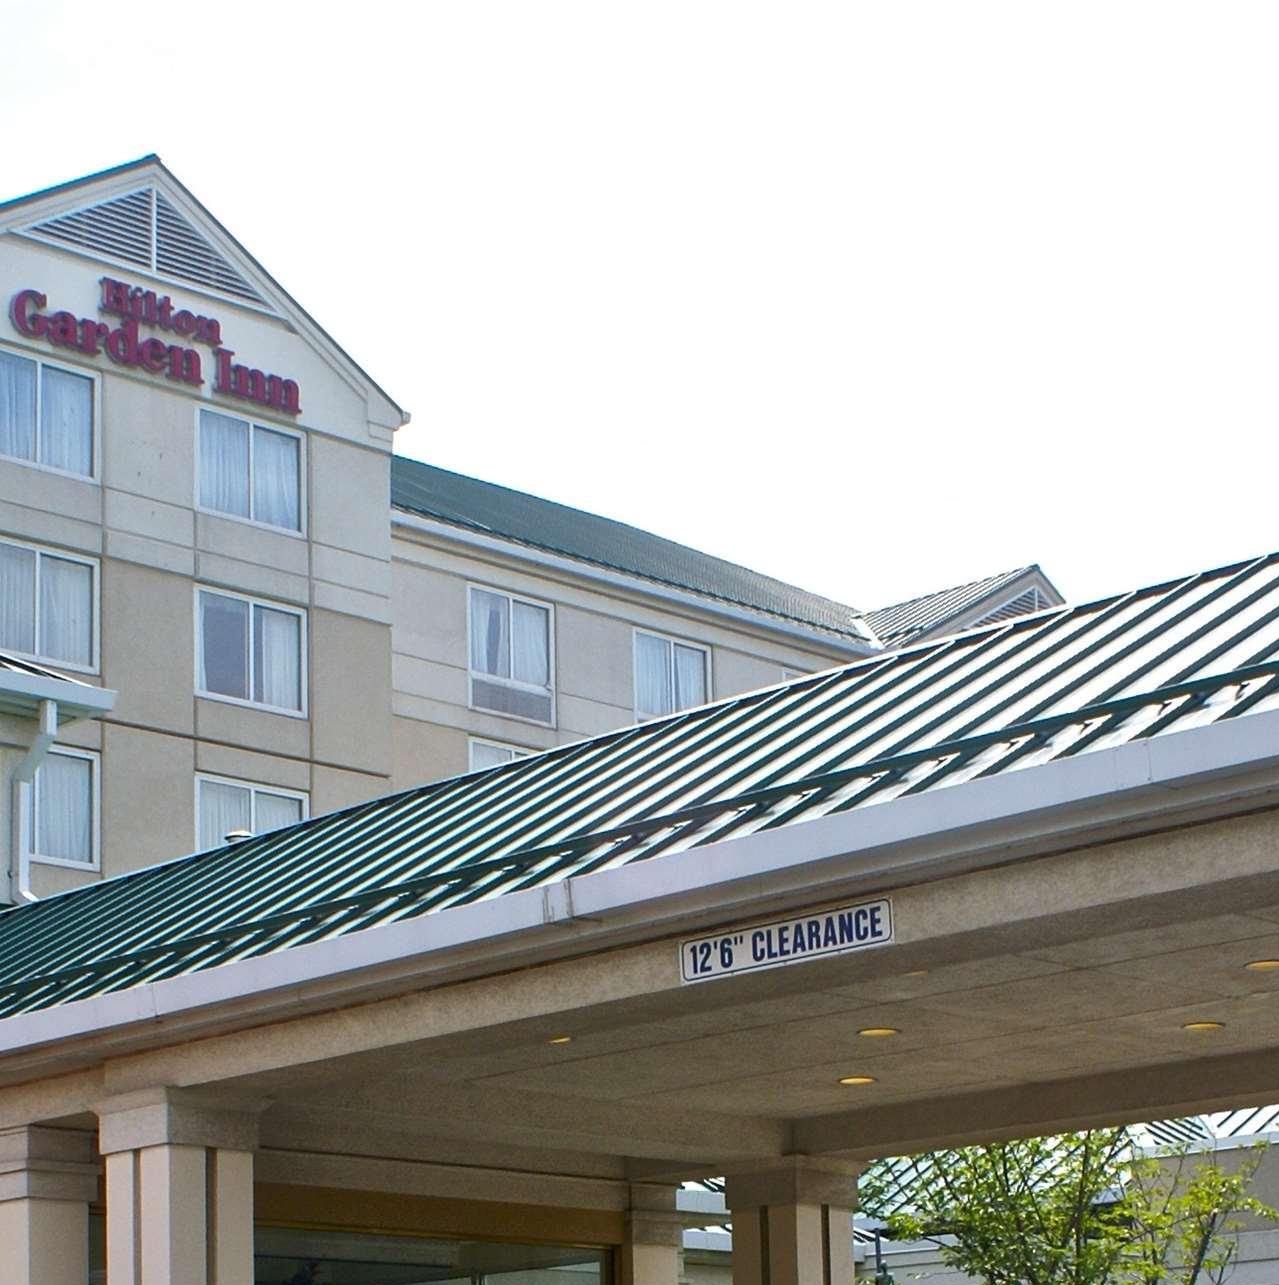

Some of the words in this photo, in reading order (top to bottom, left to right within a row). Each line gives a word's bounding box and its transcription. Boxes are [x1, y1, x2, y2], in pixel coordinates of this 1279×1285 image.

[100, 277, 222, 346] Hilton
[10, 289, 204, 386] Garden
[214, 347, 302, 415] Inn
[690, 935, 743, 974] 12'6"
[752, 905, 883, 962] CLEARANCE
